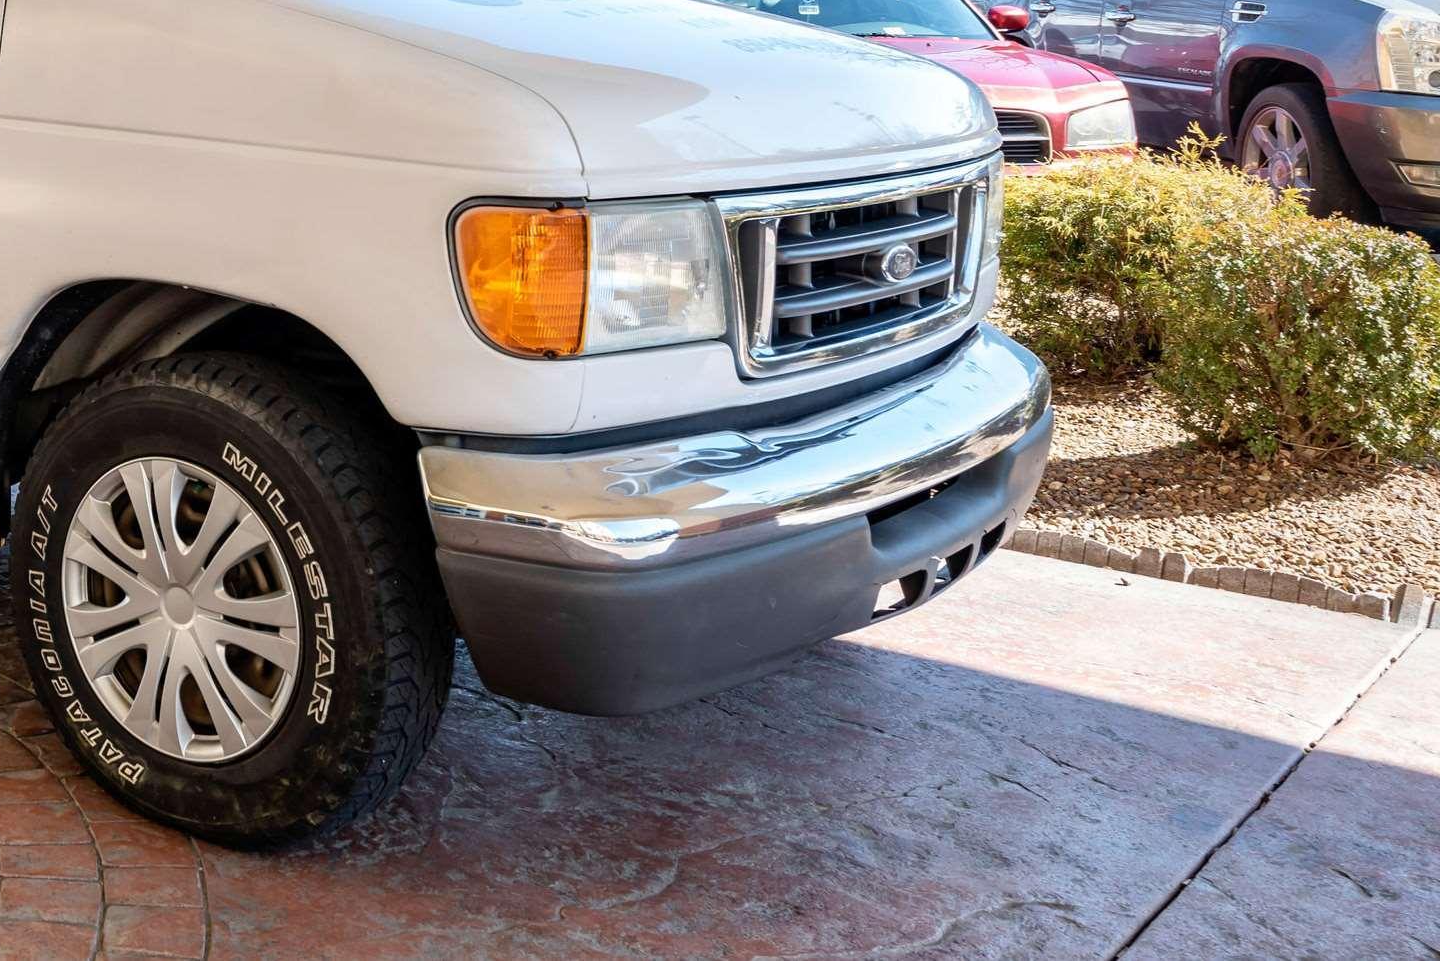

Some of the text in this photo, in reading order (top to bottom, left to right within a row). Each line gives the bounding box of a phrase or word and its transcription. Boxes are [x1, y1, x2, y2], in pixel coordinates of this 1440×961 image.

[28, 484, 145, 785] PATAGONIA A/T
[222, 441, 336, 725] MILESTAR
